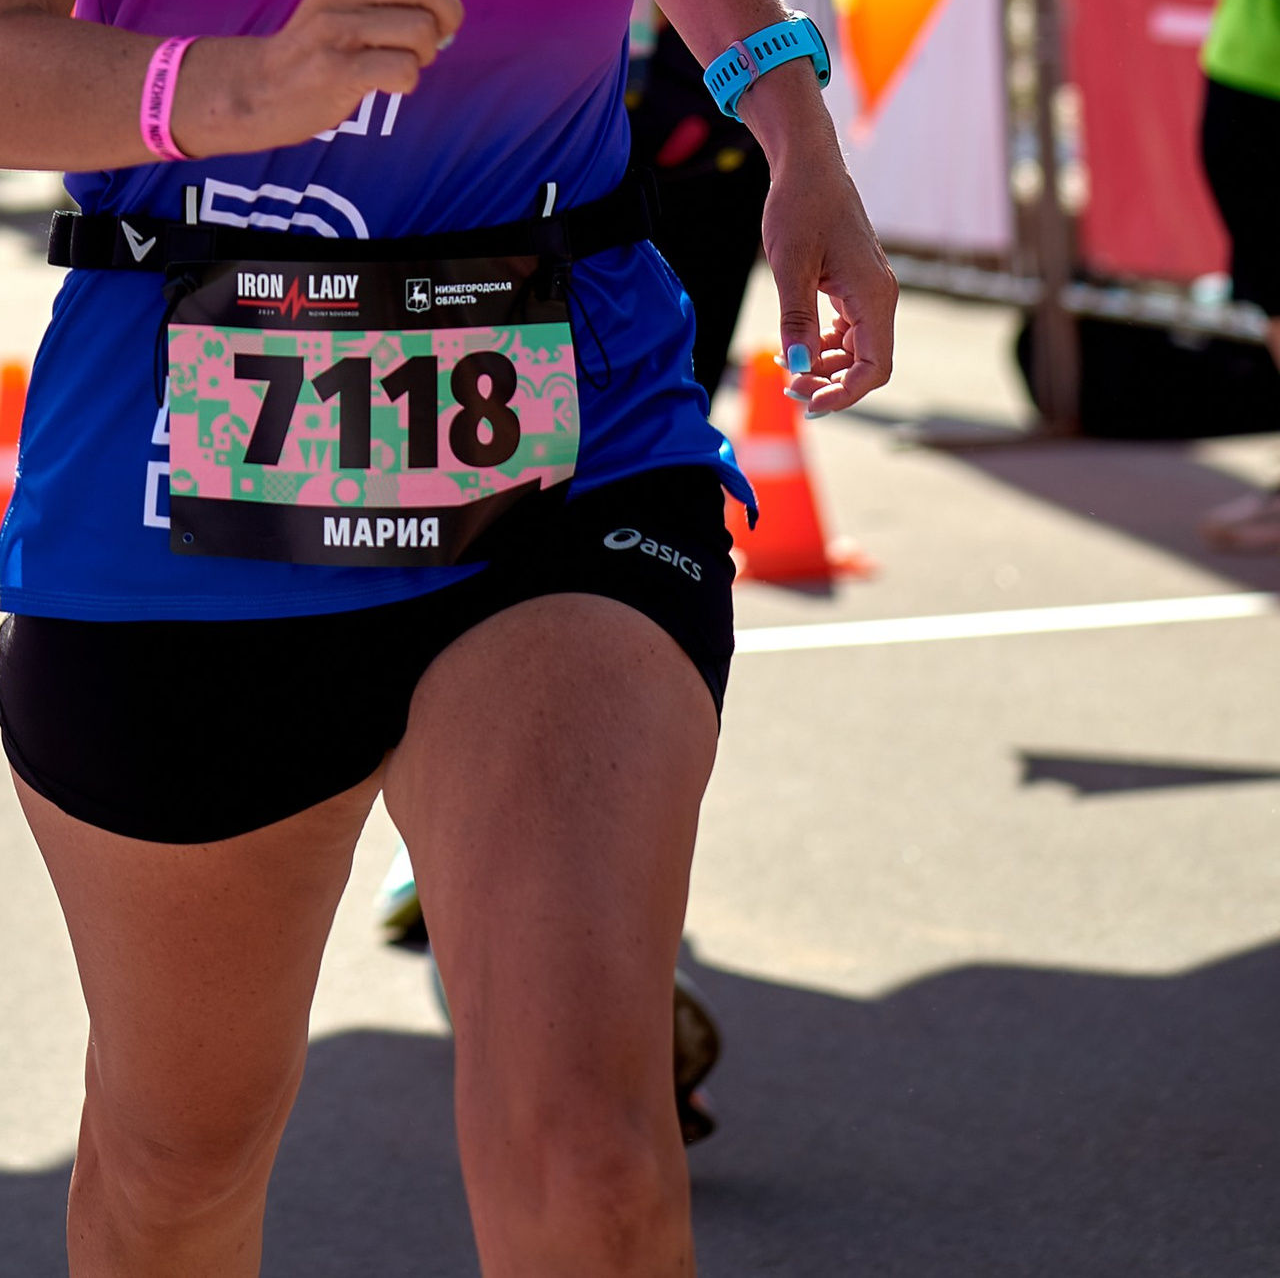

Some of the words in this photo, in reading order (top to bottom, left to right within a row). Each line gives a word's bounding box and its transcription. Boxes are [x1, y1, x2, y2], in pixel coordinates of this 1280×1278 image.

[237, 272, 283, 298] IRON
[308, 274, 359, 299] LADY
[435, 282, 512, 295] НИЖЕГОРОДСКАЯ
[435, 295, 477, 305] ОБЛАСТЬ
[233, 351, 521, 470] 7118
[323, 516, 440, 548] МАРИЯ
[639, 537, 702, 582] asics
